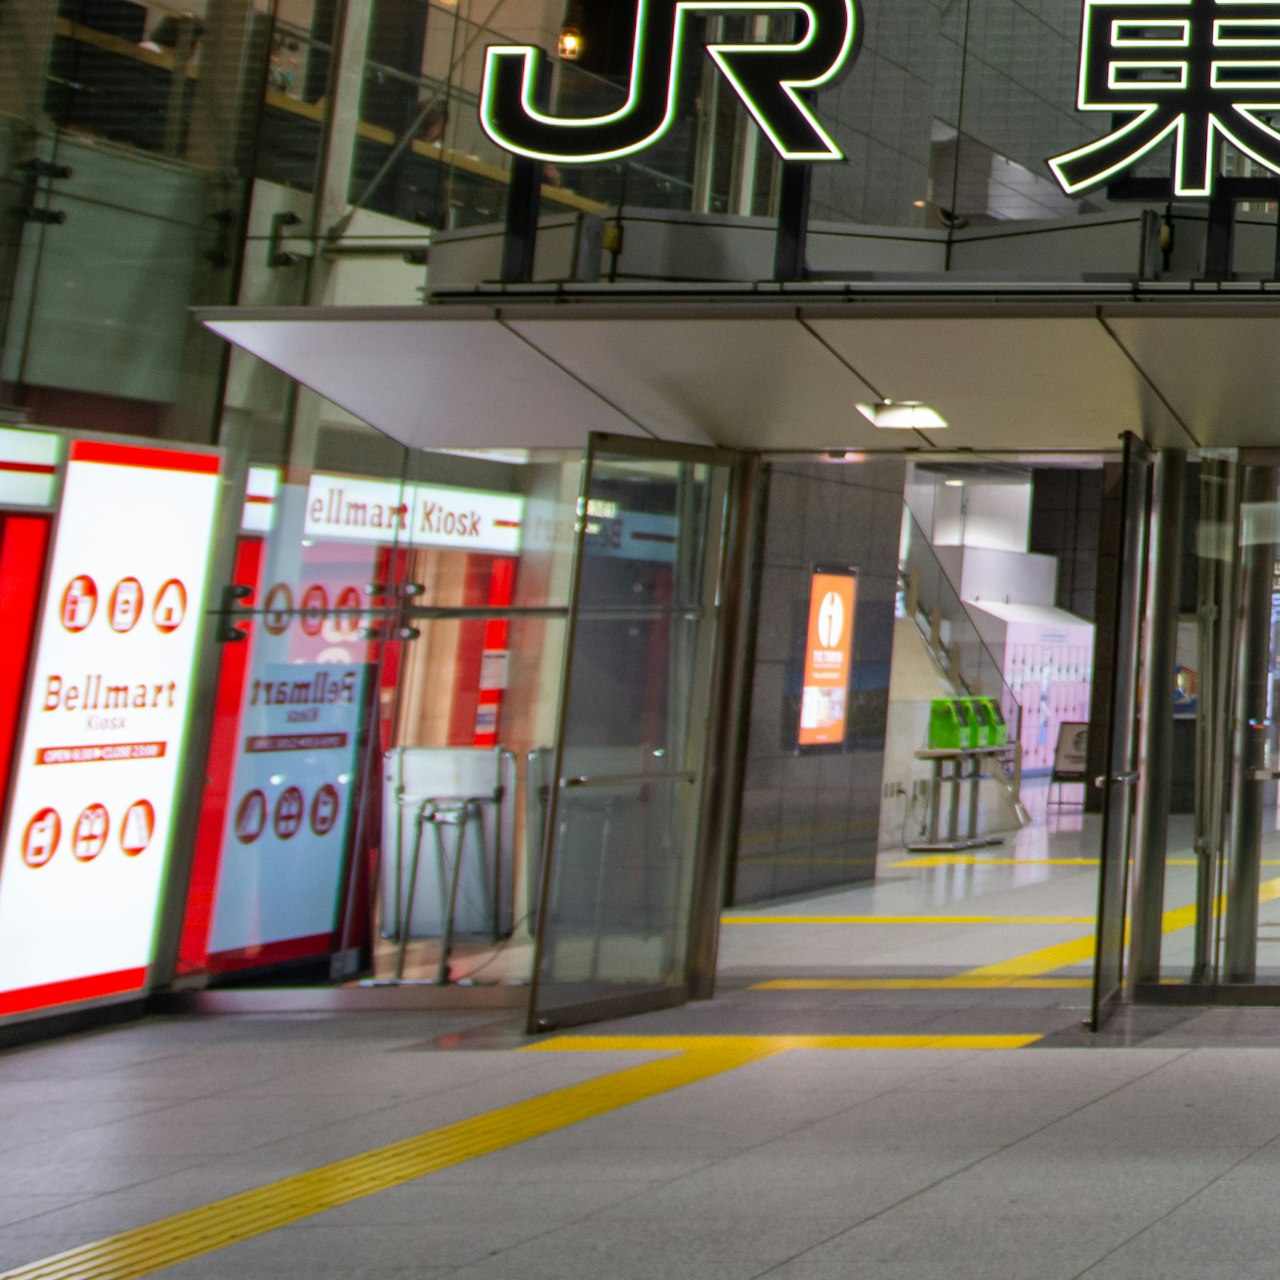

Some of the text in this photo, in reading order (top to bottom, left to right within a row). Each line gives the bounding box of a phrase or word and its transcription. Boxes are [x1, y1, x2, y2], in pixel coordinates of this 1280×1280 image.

[309, 488, 482, 538] ellmart Kiosk
[41, 674, 178, 712] Bellmart
[86, 714, 127, 732] Kiosk
